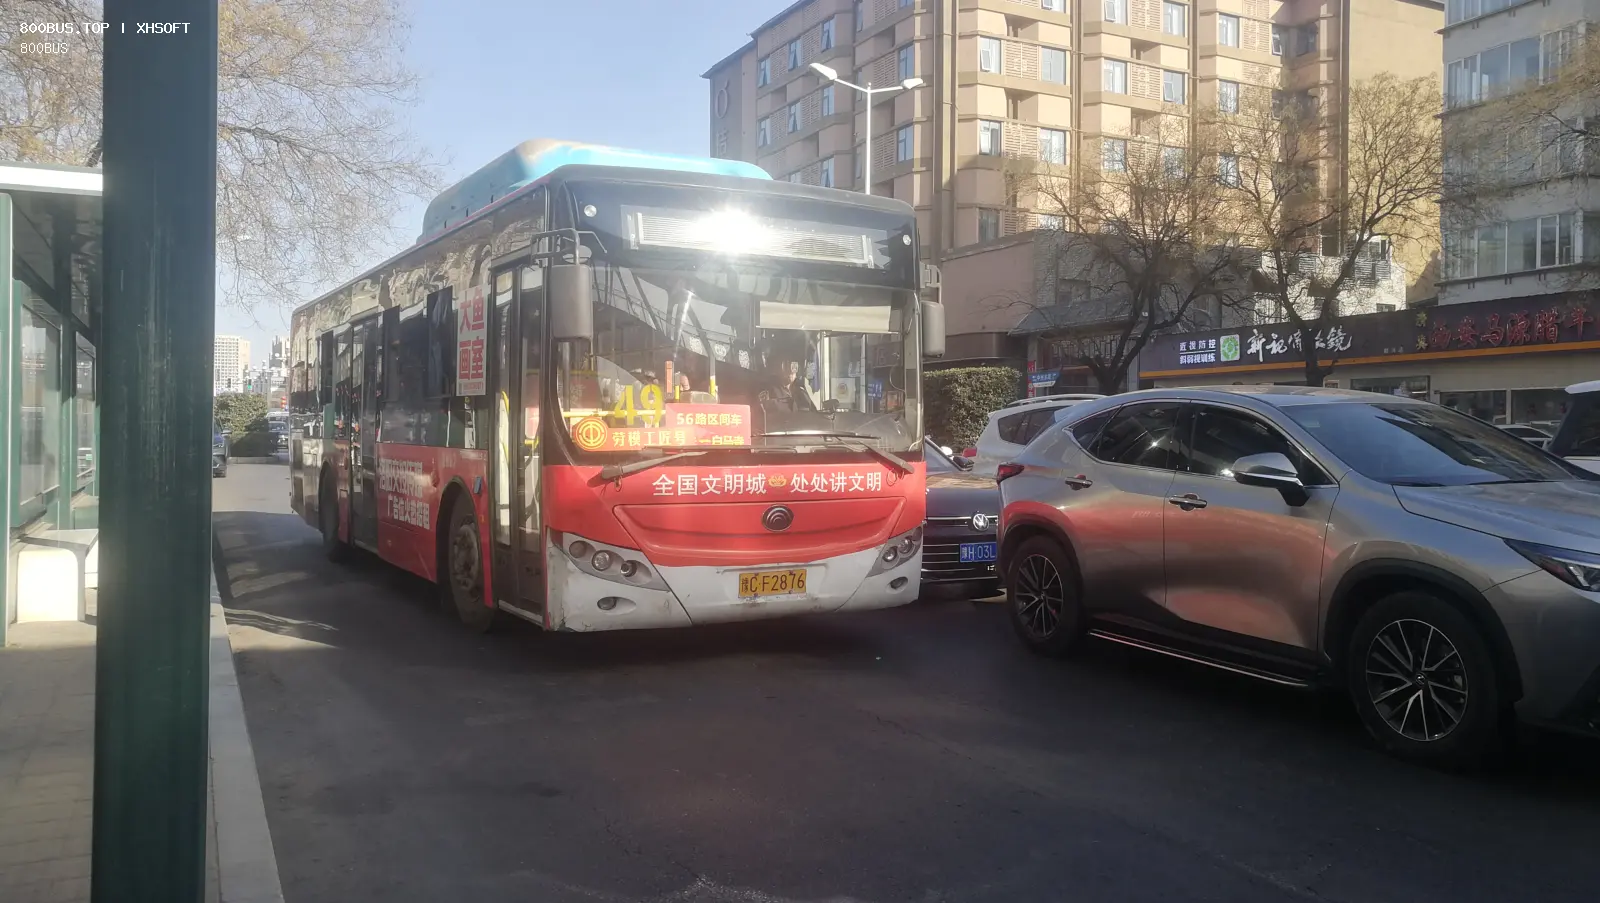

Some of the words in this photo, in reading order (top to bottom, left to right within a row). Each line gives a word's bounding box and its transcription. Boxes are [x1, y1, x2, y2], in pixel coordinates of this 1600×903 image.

[1179, 338, 1217, 352] 近视防控
[613, 383, 665, 427] 49
[612, 430, 686, 448] 劳模工匠号
[652, 473, 767, 497] 全国文明城
[790, 471, 883, 494] 处处讲文明
